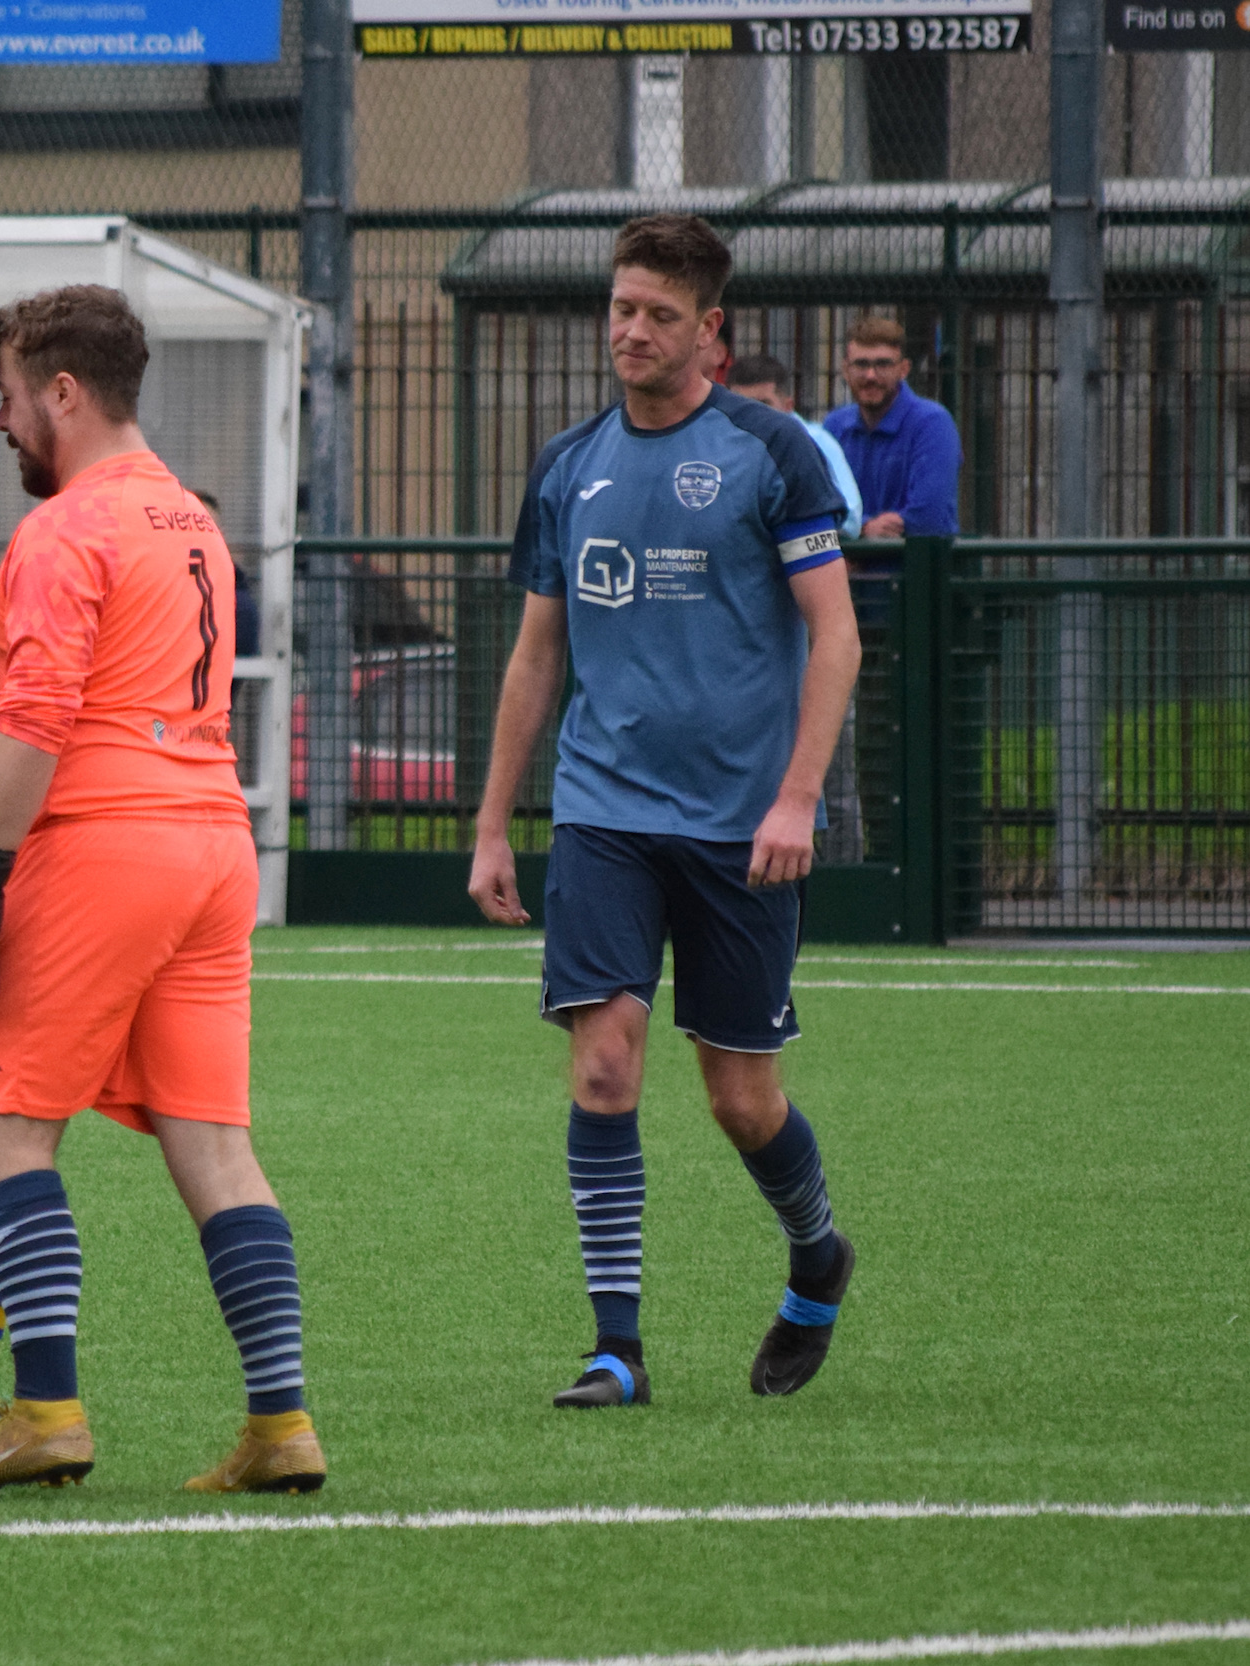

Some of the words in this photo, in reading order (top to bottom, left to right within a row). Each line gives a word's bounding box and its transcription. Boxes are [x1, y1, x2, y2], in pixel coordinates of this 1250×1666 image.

[1124, 6, 1168, 29] Find
[1172, 10, 1196, 29] us
[1201, 9, 1226, 29] on
[361, 26, 417, 53] SALES
[429, 26, 507, 52] REPAIRS
[521, 25, 606, 51] DELIVERY
[624, 24, 733, 50] COLLECTION
[750, 22, 802, 51] Tel:
[808, 19, 901, 50] 07533
[907, 18, 1021, 49] 922587
[645, 548, 659, 559] GJ
[661, 549, 709, 560] PROPERTY
[646, 561, 708, 572] MAINTENANCE
[188, 548, 219, 712] 1
